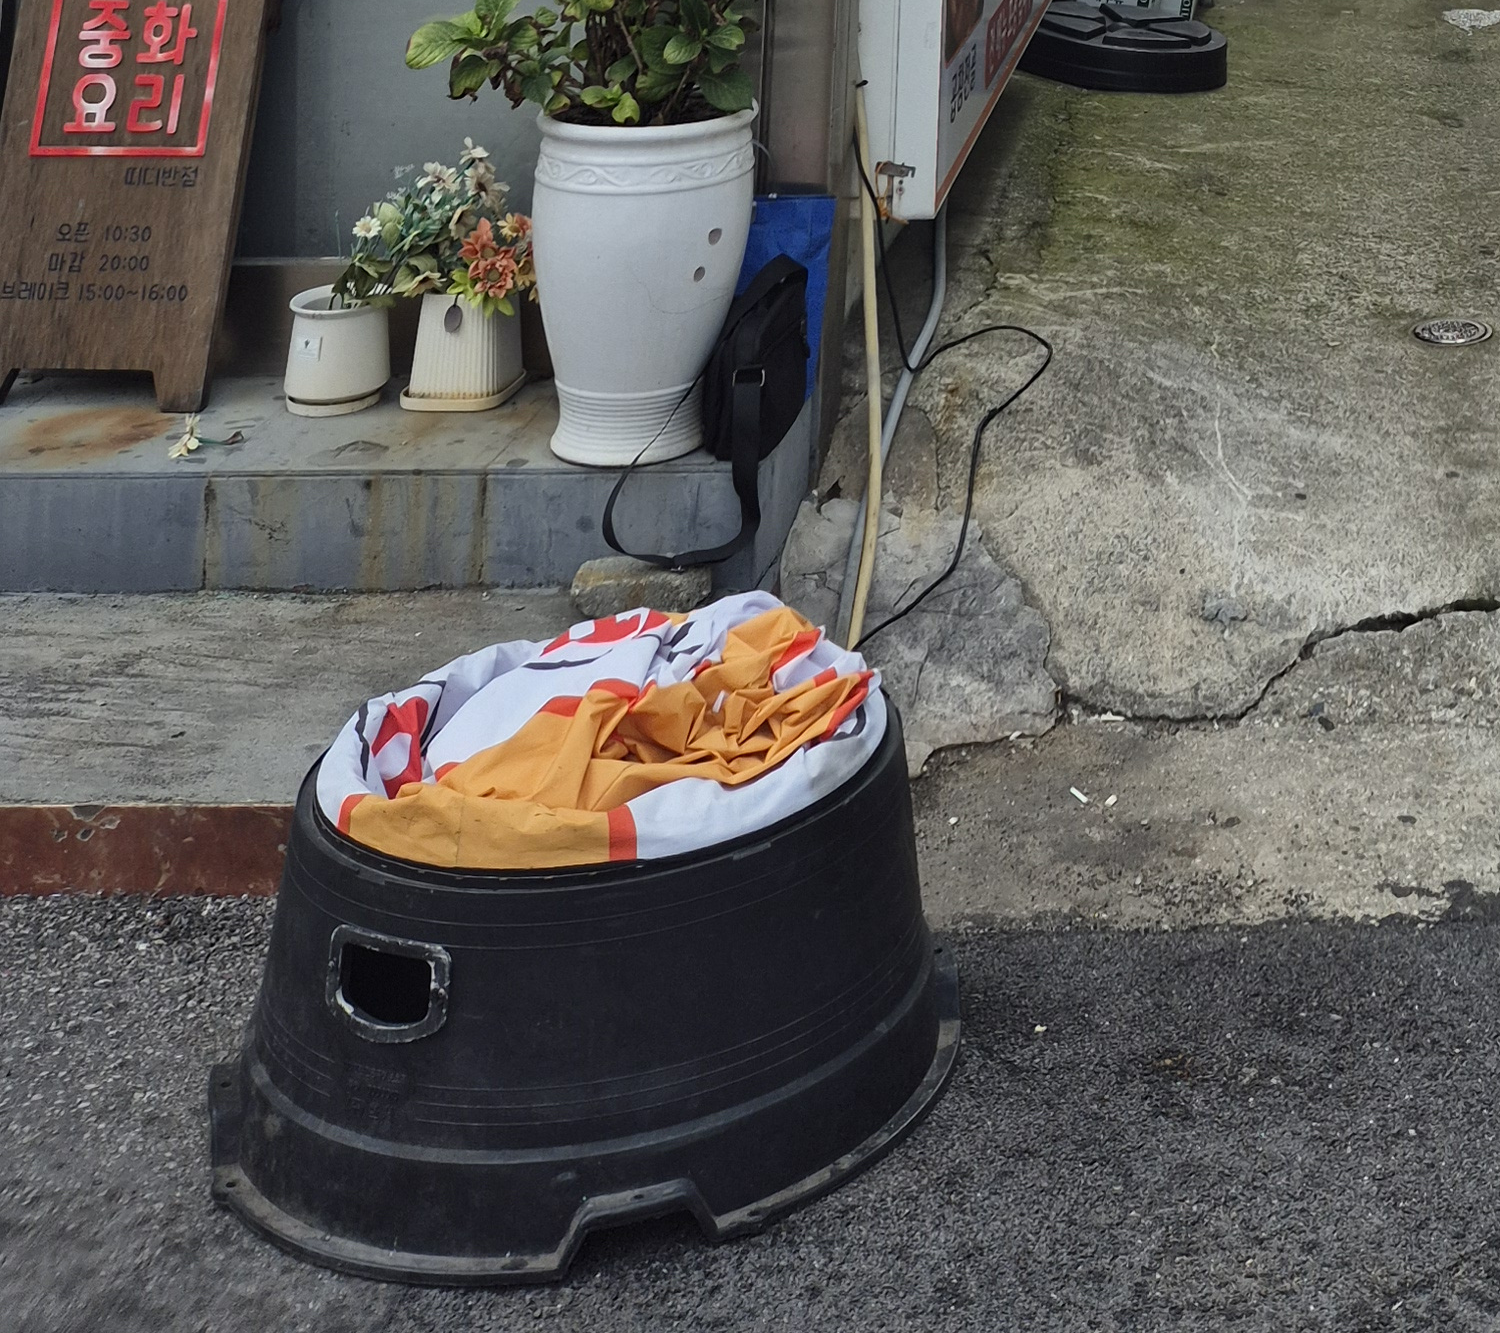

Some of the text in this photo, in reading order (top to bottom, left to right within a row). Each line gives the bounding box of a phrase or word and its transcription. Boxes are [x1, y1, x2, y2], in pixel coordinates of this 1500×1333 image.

[63, 73, 185, 135] 요리
[124, 165, 199, 188] 띠디반점
[56, 221, 152, 243] 오픈 10:30
[48, 251, 150, 274] 마감 20:00
[0, 280, 70, 301] 브레이크
